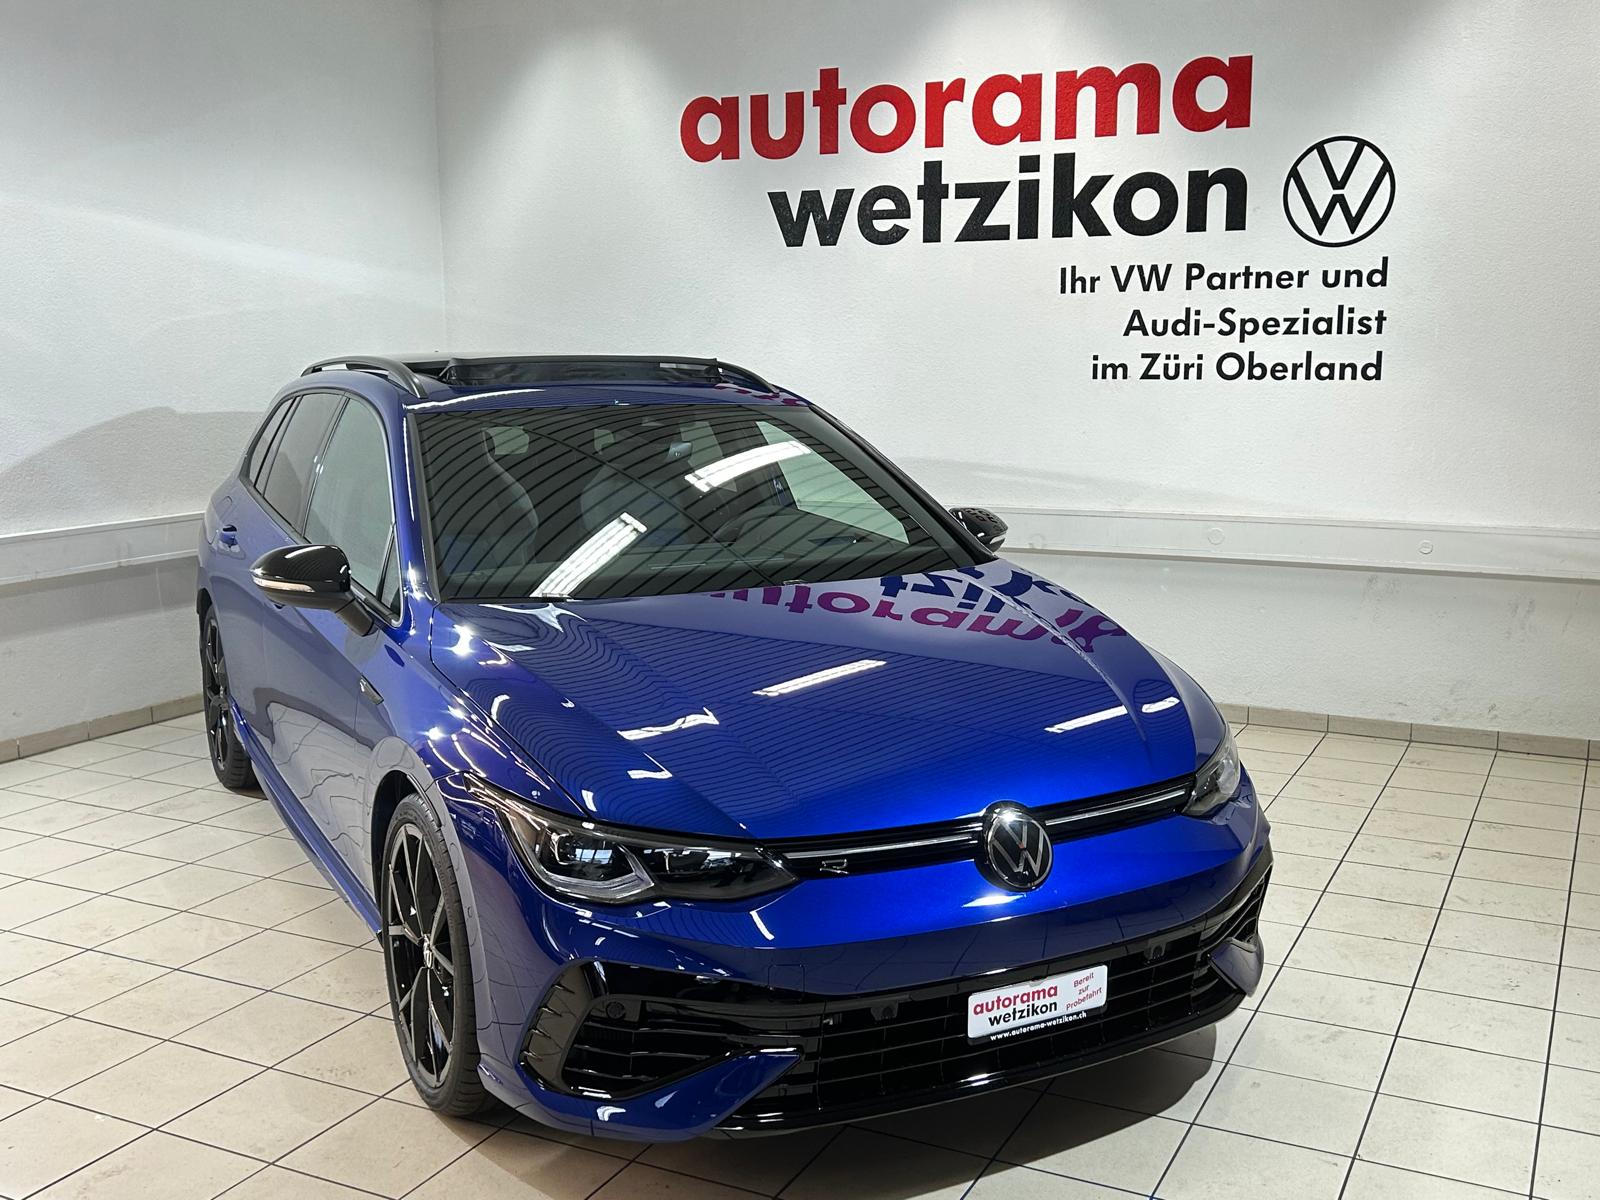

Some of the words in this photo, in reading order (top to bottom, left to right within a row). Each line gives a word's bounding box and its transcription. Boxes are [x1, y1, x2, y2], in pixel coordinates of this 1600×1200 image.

[680, 55, 1254, 163] autorama
[768, 153, 1248, 248] wetzikon
[1060, 265, 1101, 295] Ihr
[1110, 264, 1173, 293] VW
[1185, 262, 1310, 291] Partner
[1322, 256, 1389, 289] und
[1122, 304, 1387, 344] Audi-Spezialist
[1092, 354, 1129, 380] im
[1139, 352, 1204, 381] Züri
[1215, 350, 1383, 381] Oberland
[1073, 972, 1094, 988] Bereit
[1078, 984, 1090, 995] zur
[973, 985, 1058, 1016] autorama
[988, 1001, 1058, 1027] wetzikon
[1066, 987, 1102, 1011] Probefahrt
[990, 1011, 1087, 1041] www.autorama-wetzikon.ch
